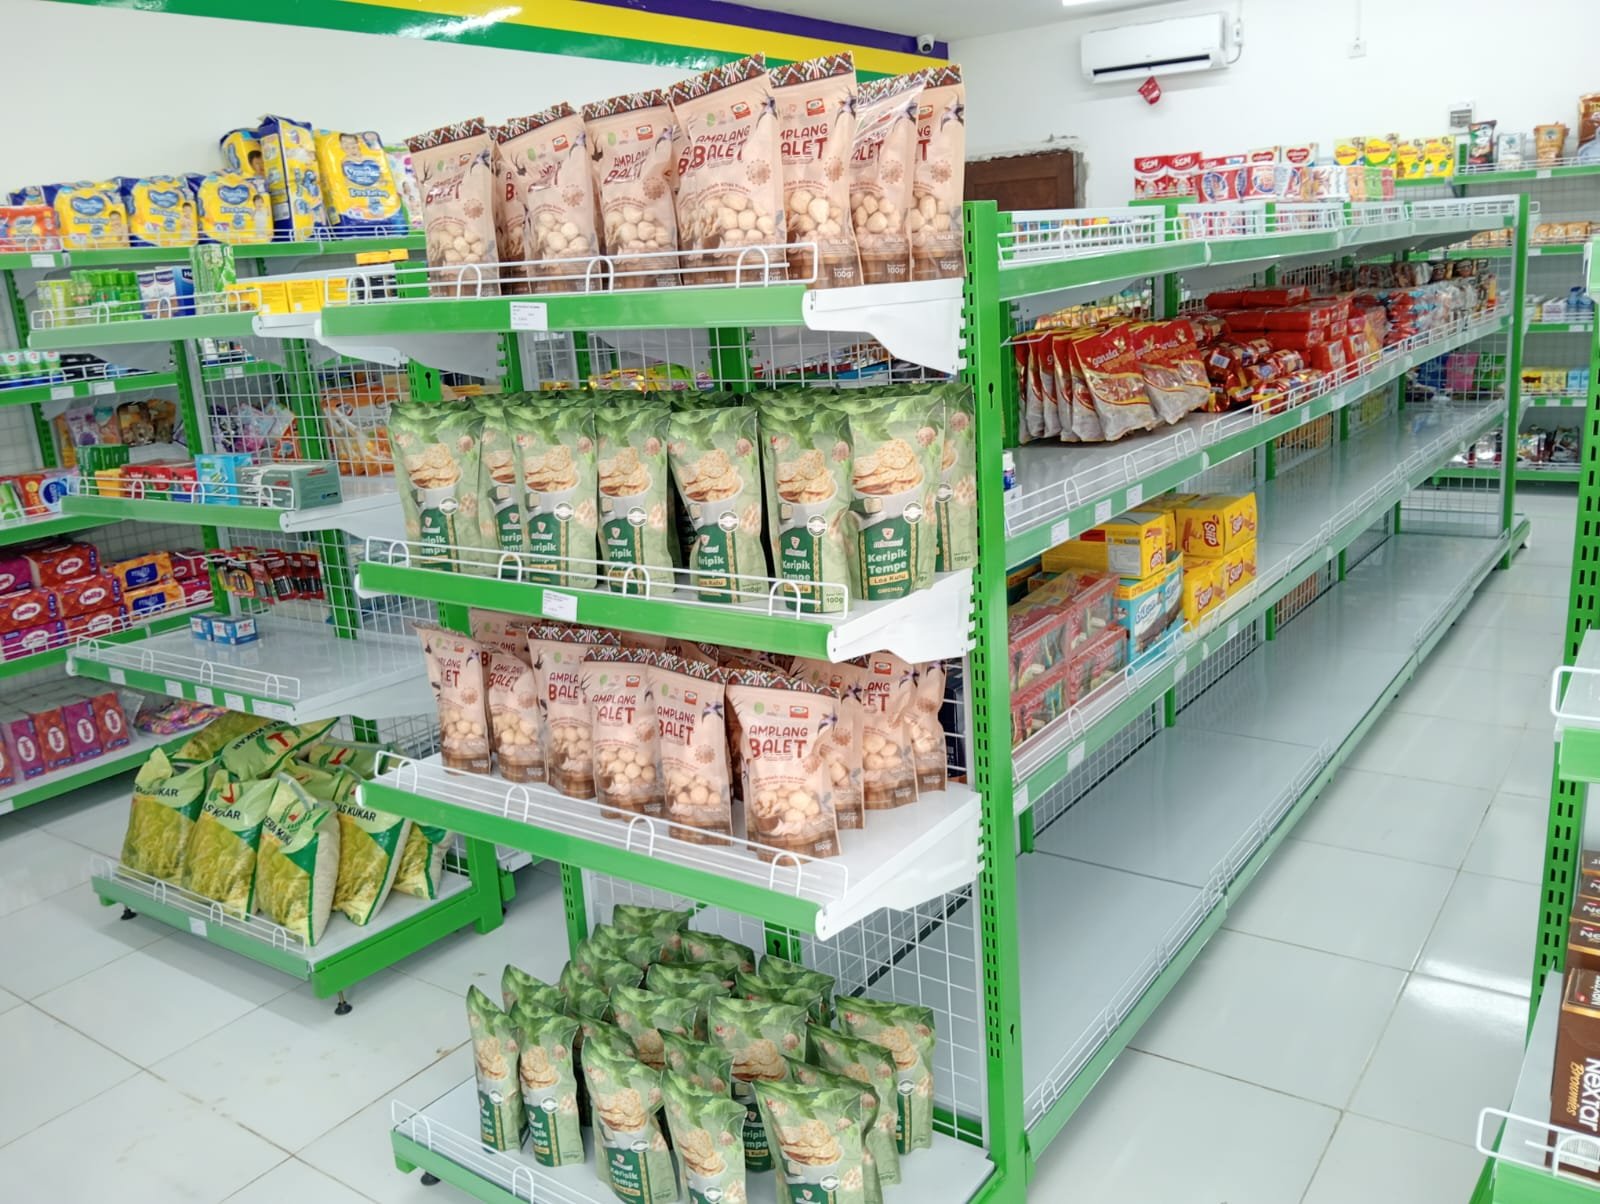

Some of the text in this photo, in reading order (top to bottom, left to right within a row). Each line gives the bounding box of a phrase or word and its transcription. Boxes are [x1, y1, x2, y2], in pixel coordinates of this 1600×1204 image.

[696, 125, 751, 143] AMPLANG
[780, 123, 828, 140] PLANG
[693, 139, 748, 168] BALET
[781, 137, 828, 160] ALET
[852, 140, 885, 162] ALET
[868, 549, 907, 564] Keripik
[783, 560, 810, 571] Keripik
[868, 561, 907, 574] Tempe
[550, 672, 579, 683] AMPLA
[592, 694, 636, 705] AMPLANG
[597, 706, 636, 724] ALET
[657, 706, 695, 724] AMPLANG
[749, 725, 808, 737] AMPLANG
[749, 738, 808, 760] BALET
[348, 807, 377, 822] KUKAR
[1566, 1061, 1584, 1117] Brownies
